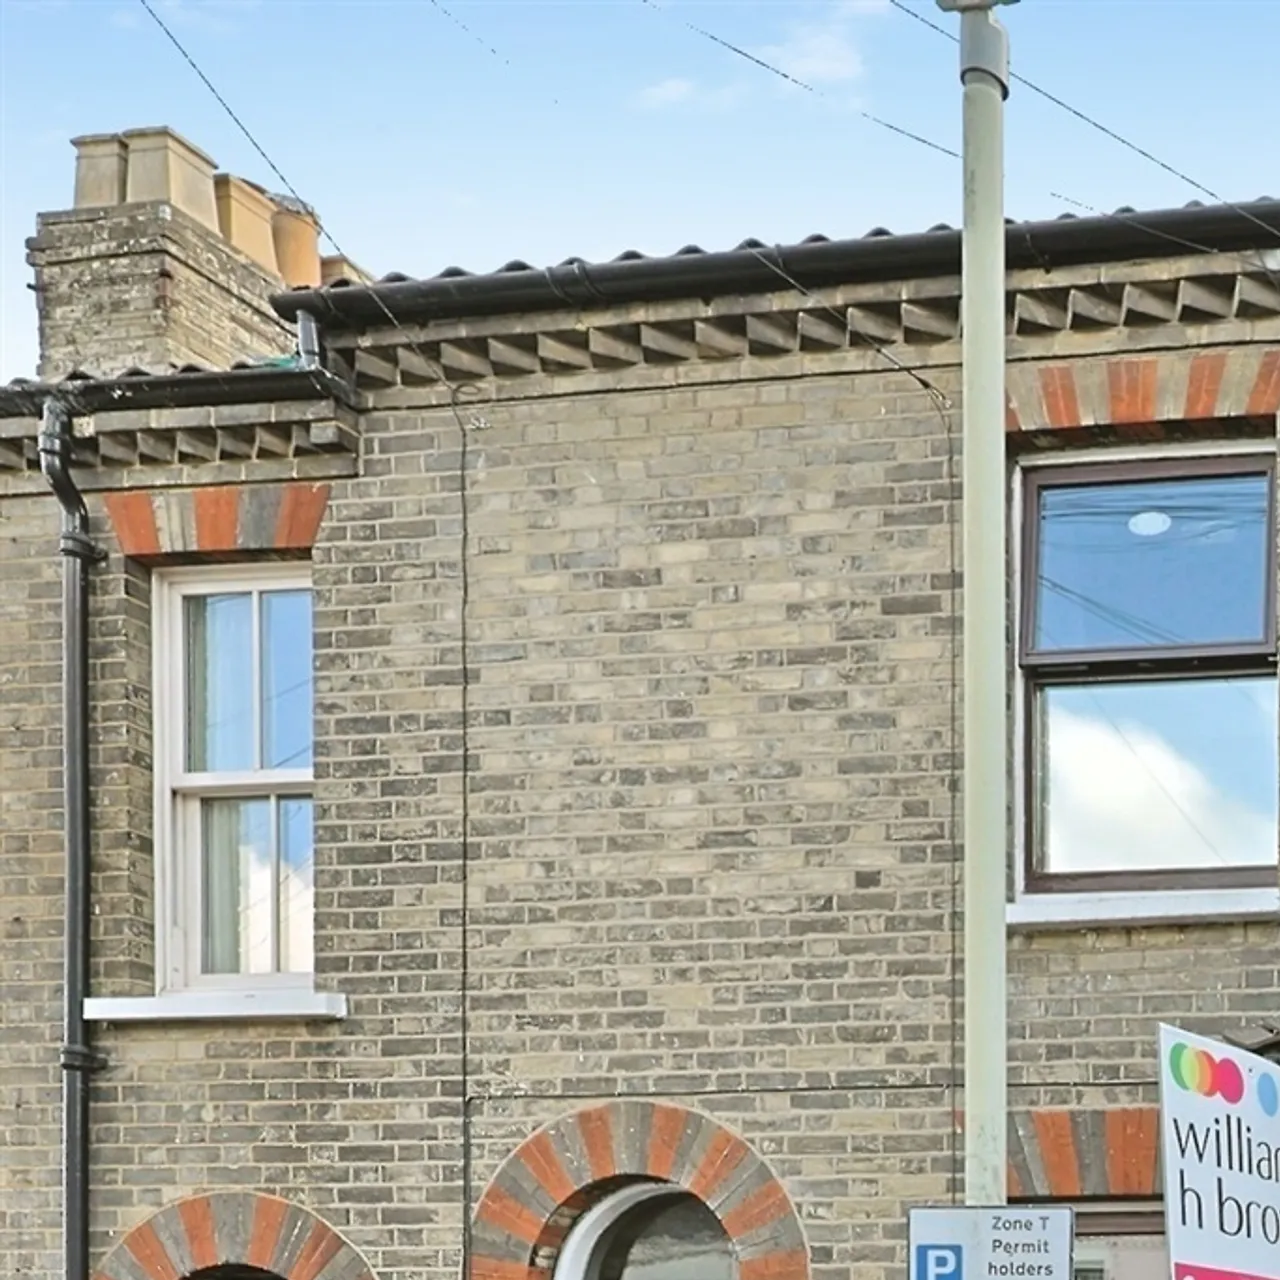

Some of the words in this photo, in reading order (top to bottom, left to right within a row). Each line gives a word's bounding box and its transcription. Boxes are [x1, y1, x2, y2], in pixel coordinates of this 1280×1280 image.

[1180, 1168, 1204, 1230] h
[992, 1216, 1033, 1231] Zone
[1039, 1216, 1050, 1231] T
[992, 1239, 1050, 1254] Permit
[988, 1262, 1053, 1277] holders
